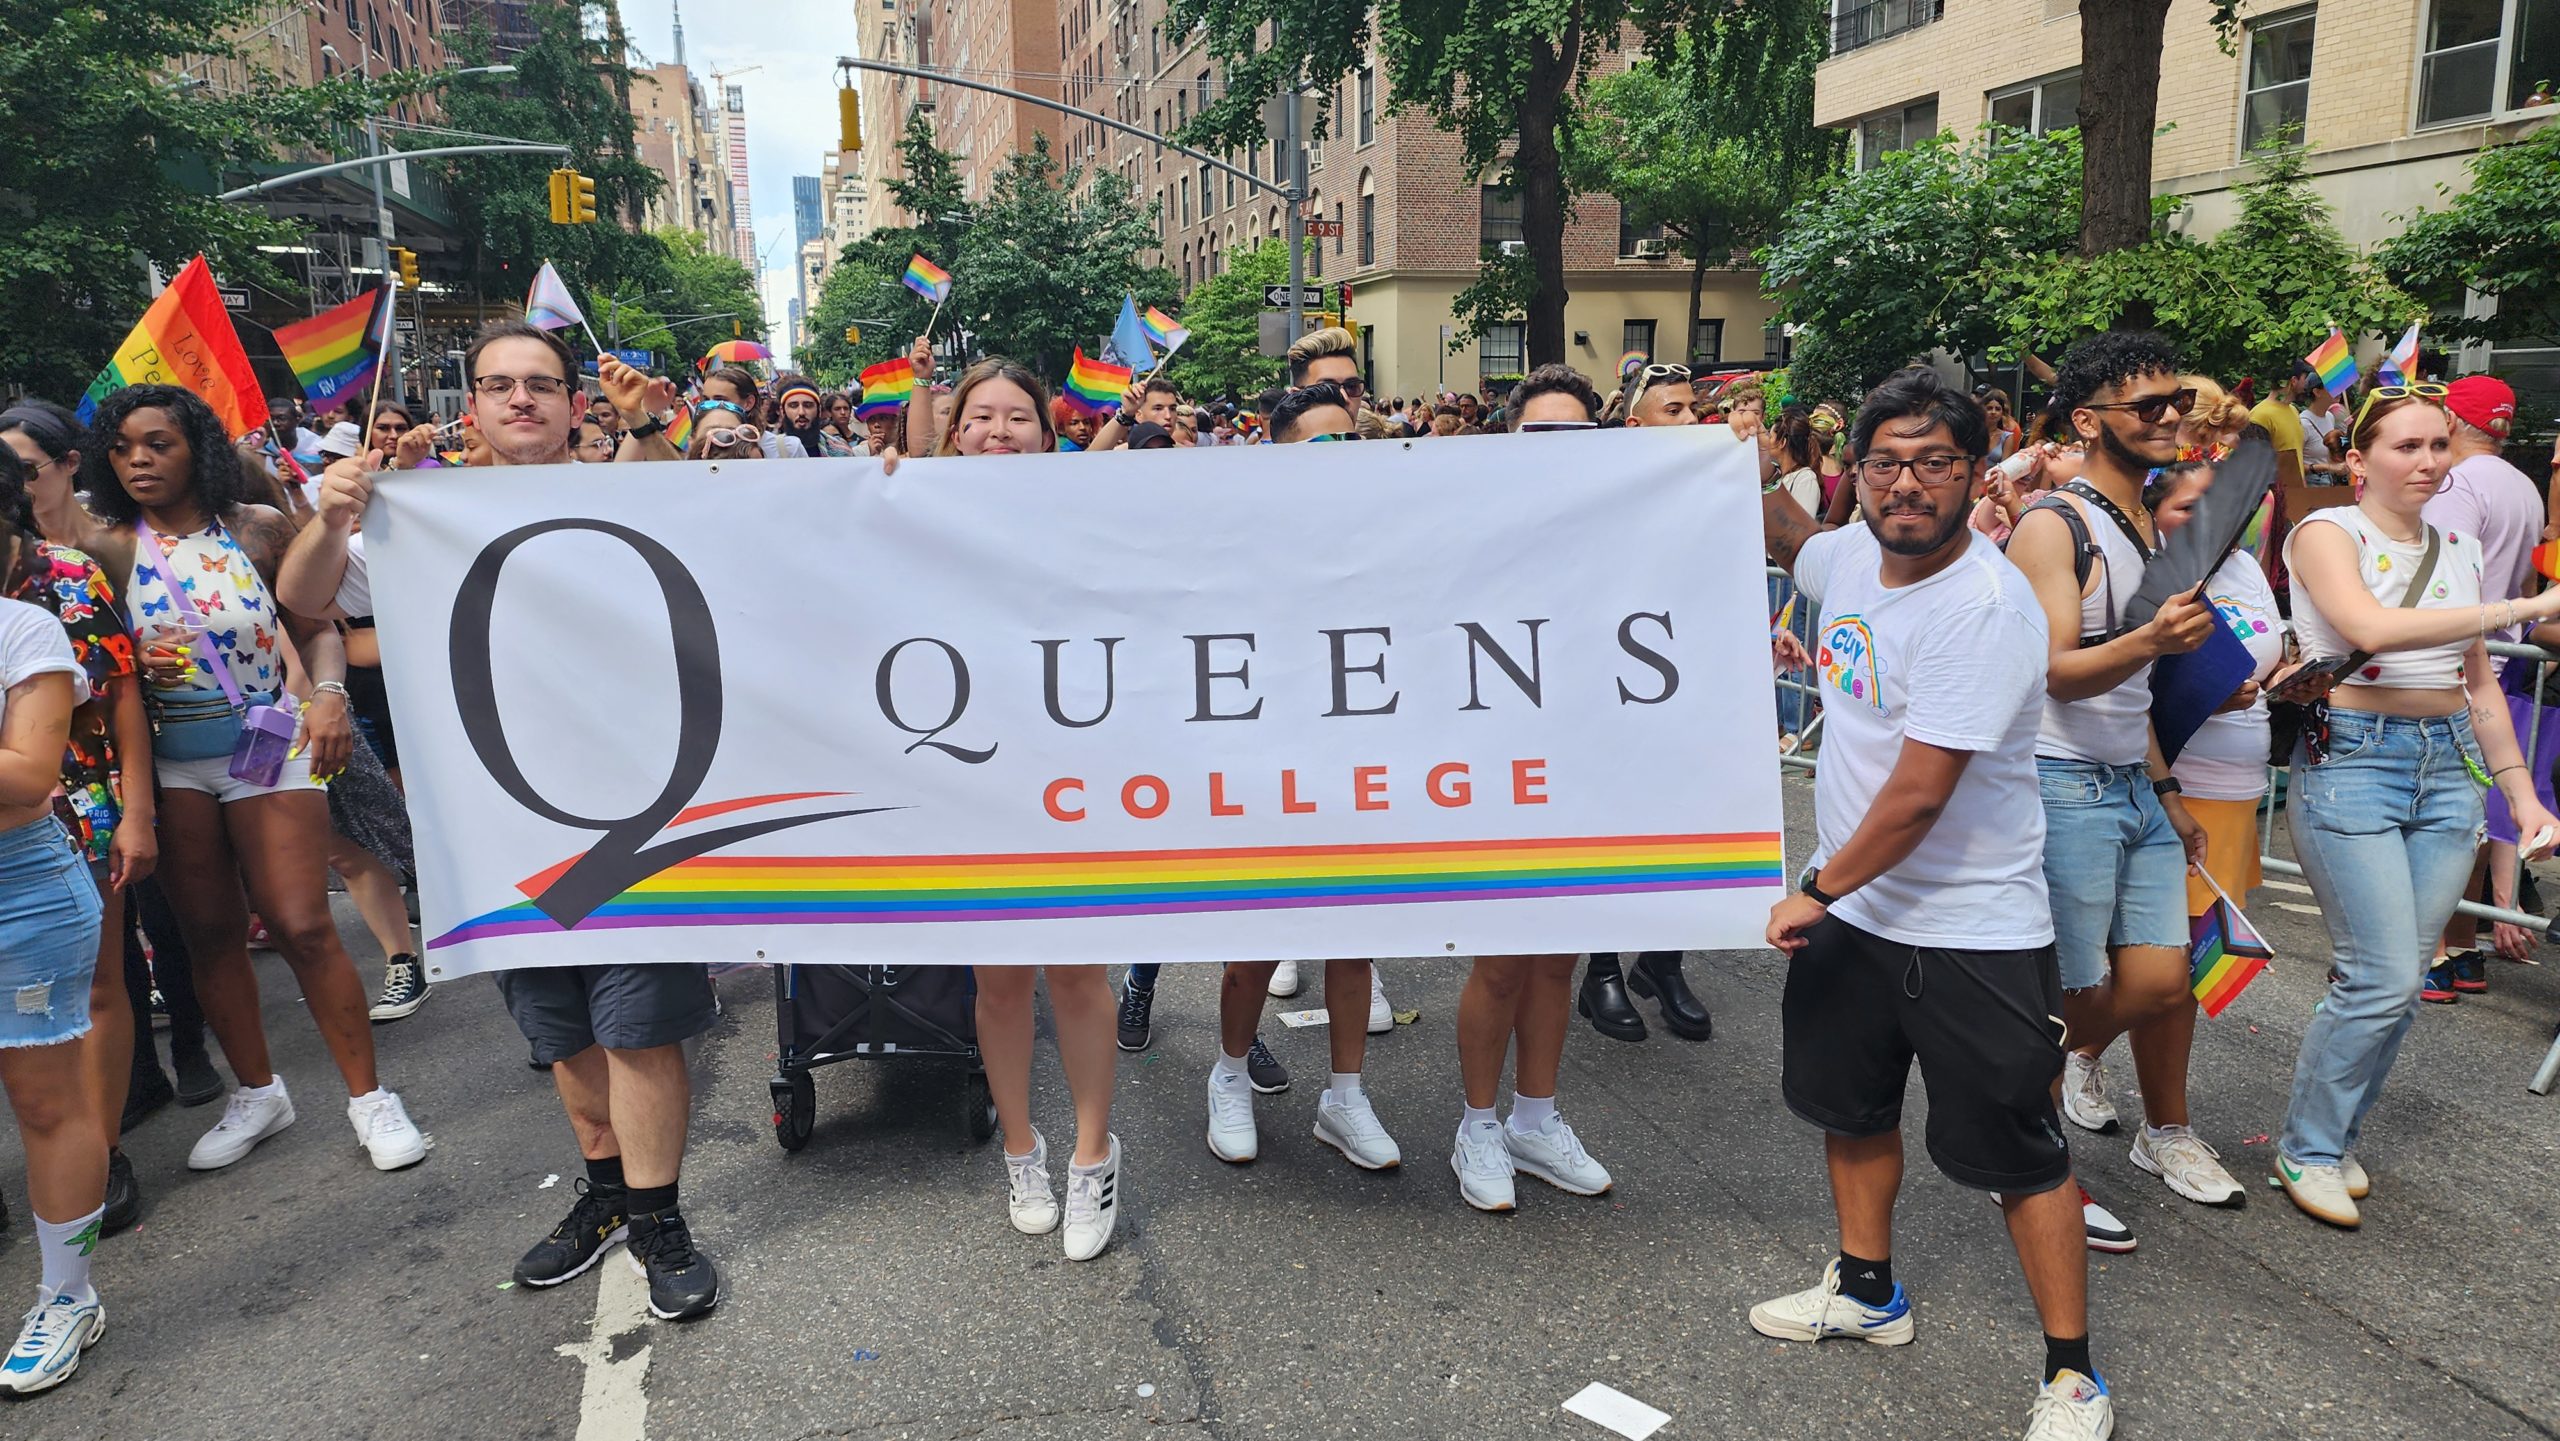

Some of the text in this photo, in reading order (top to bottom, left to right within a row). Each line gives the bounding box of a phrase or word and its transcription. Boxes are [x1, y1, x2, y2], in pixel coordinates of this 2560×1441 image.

[1307, 222, 1341, 235] E 9 ST
[1273, 291, 1290, 301] ONE
[171, 331, 216, 392] Love
[875, 610, 1681, 764] QUEENS
[1819, 645, 1864, 700] Pride
[449, 517, 920, 931] Q
[88, 809, 109, 818] PRID
[1042, 758, 1549, 822] COLLEGE
